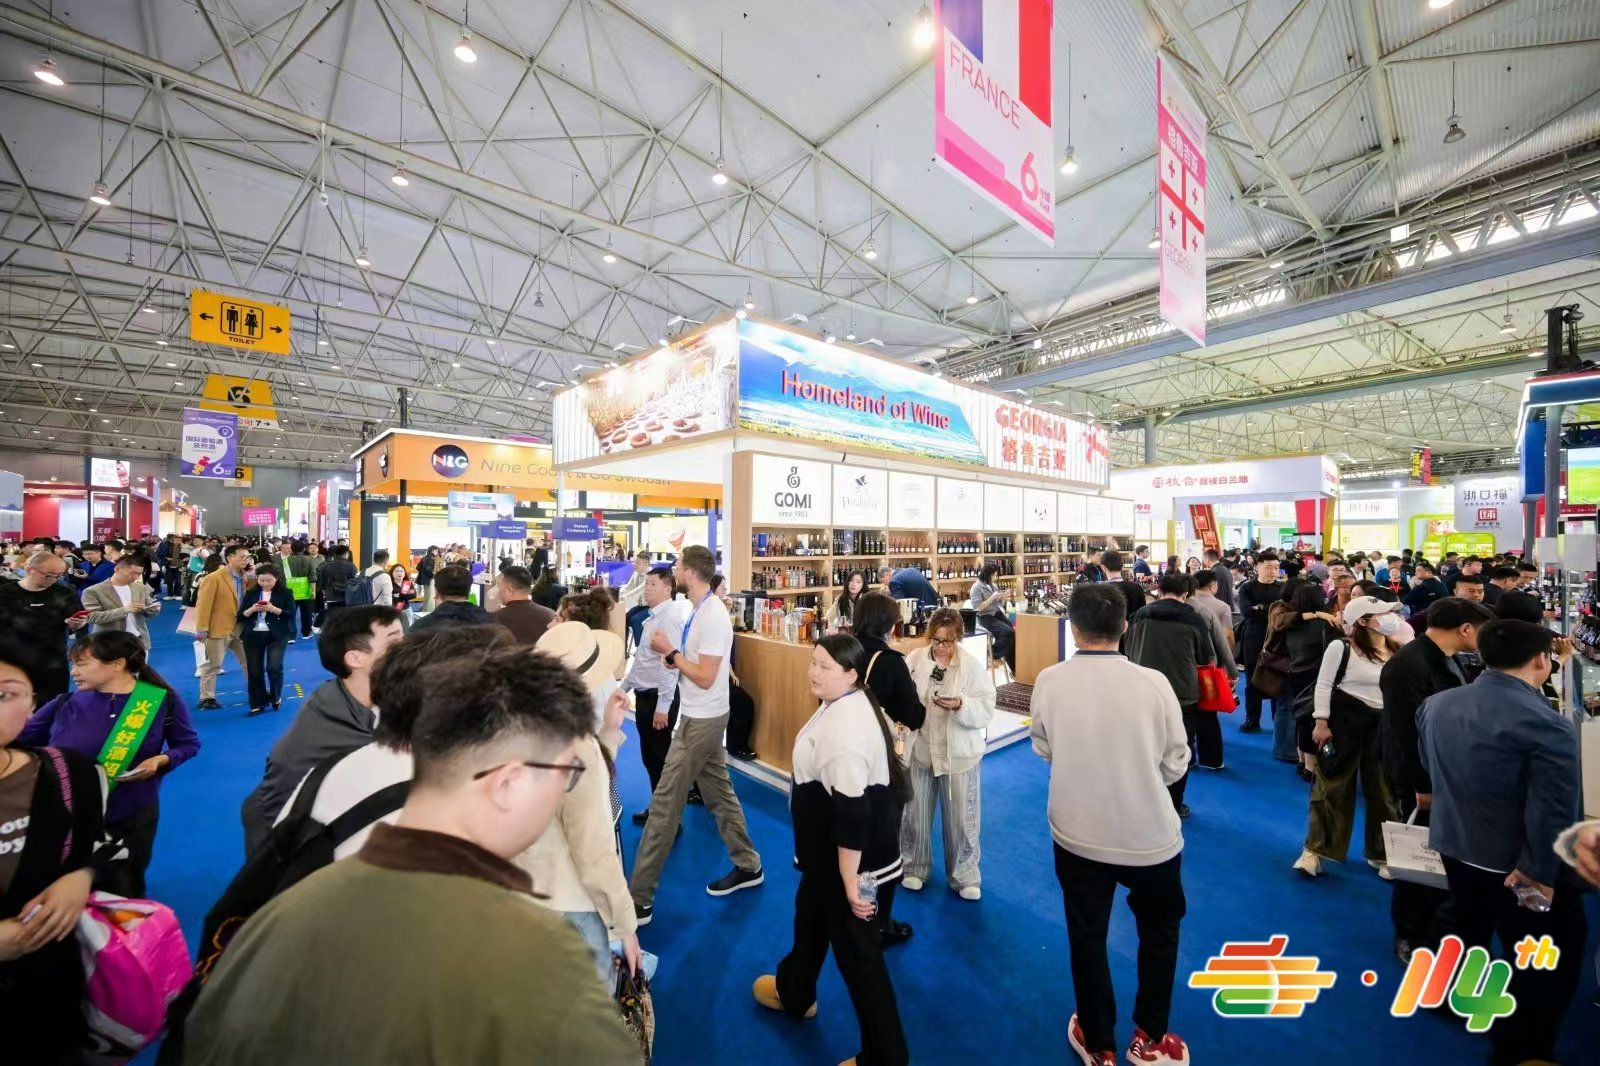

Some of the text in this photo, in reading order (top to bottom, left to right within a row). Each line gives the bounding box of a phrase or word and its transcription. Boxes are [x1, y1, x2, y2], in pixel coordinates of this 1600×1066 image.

[950, 41, 1020, 131] FRANCE
[1021, 151, 1039, 201] 6
[229, 336, 255, 345] TOILET
[781, 369, 949, 430] Homeland of Wine
[996, 404, 1067, 443] GEORGIA
[481, 458, 522, 473] Nine
[1002, 435, 1067, 471] 格鲁吉亚
[212, 463, 225, 475] 6
[235, 468, 244, 479] 6
[774, 492, 812, 509] GOMI
